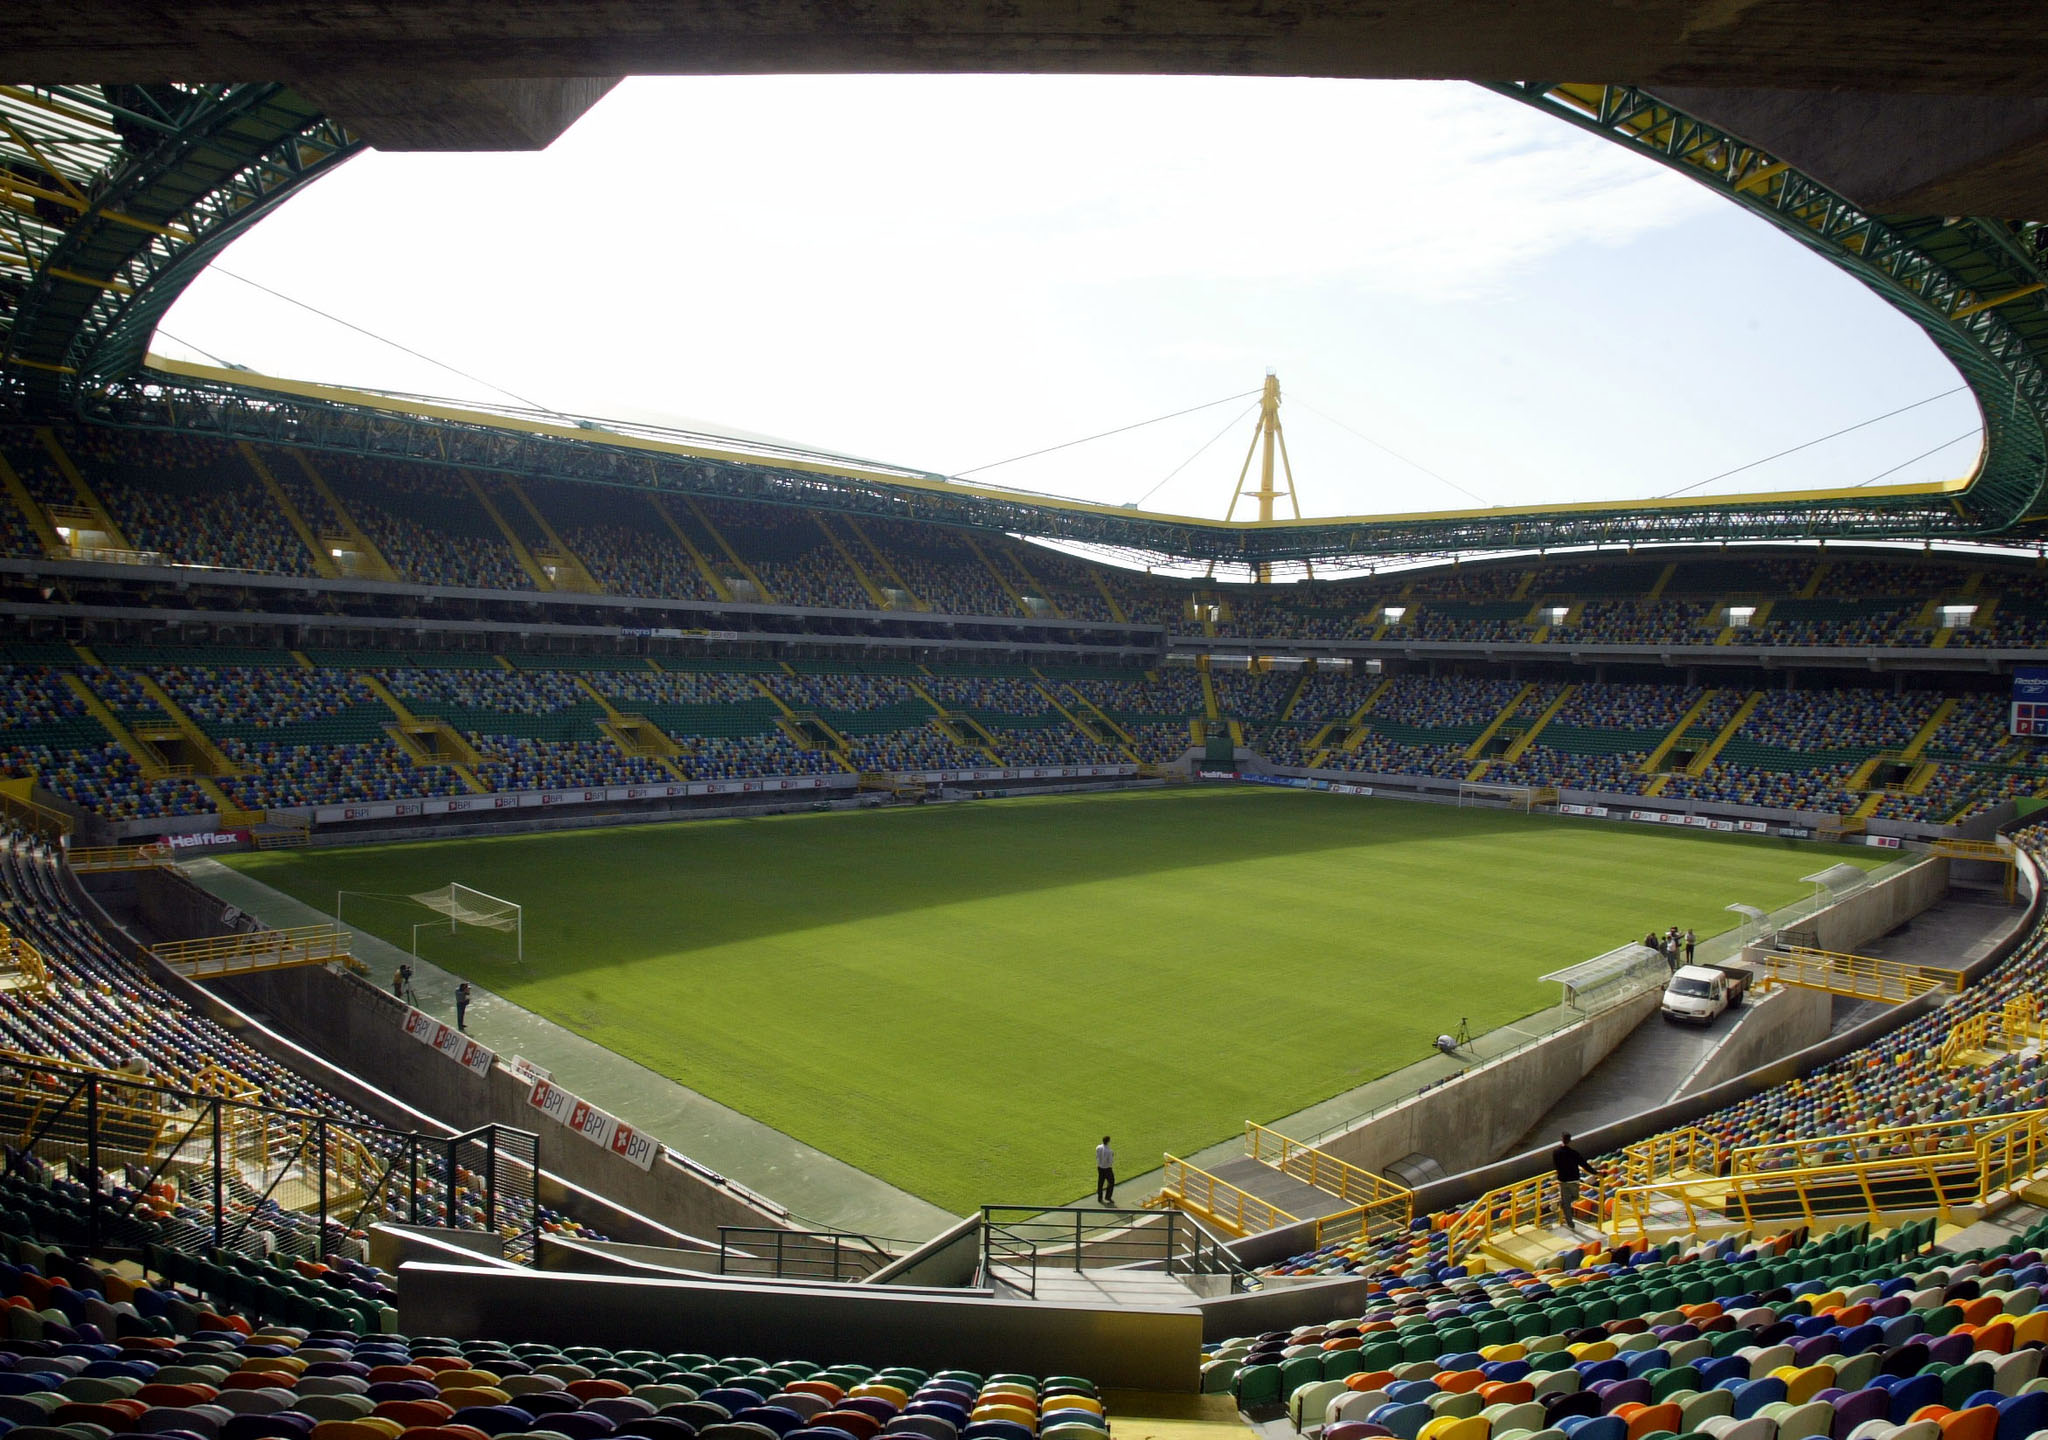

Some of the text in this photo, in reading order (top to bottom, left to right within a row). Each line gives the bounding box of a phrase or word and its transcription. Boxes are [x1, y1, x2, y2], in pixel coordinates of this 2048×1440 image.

[2014, 677, 2048, 685] Reebo
[168, 832, 237, 851] Heliflex
[414, 1018, 430, 1037] BPI
[443, 1032, 459, 1053] BPI
[471, 1050, 489, 1072] BPI
[543, 1089, 564, 1114] BPI
[584, 1112, 606, 1139] BPI
[627, 1135, 650, 1163] BPI
